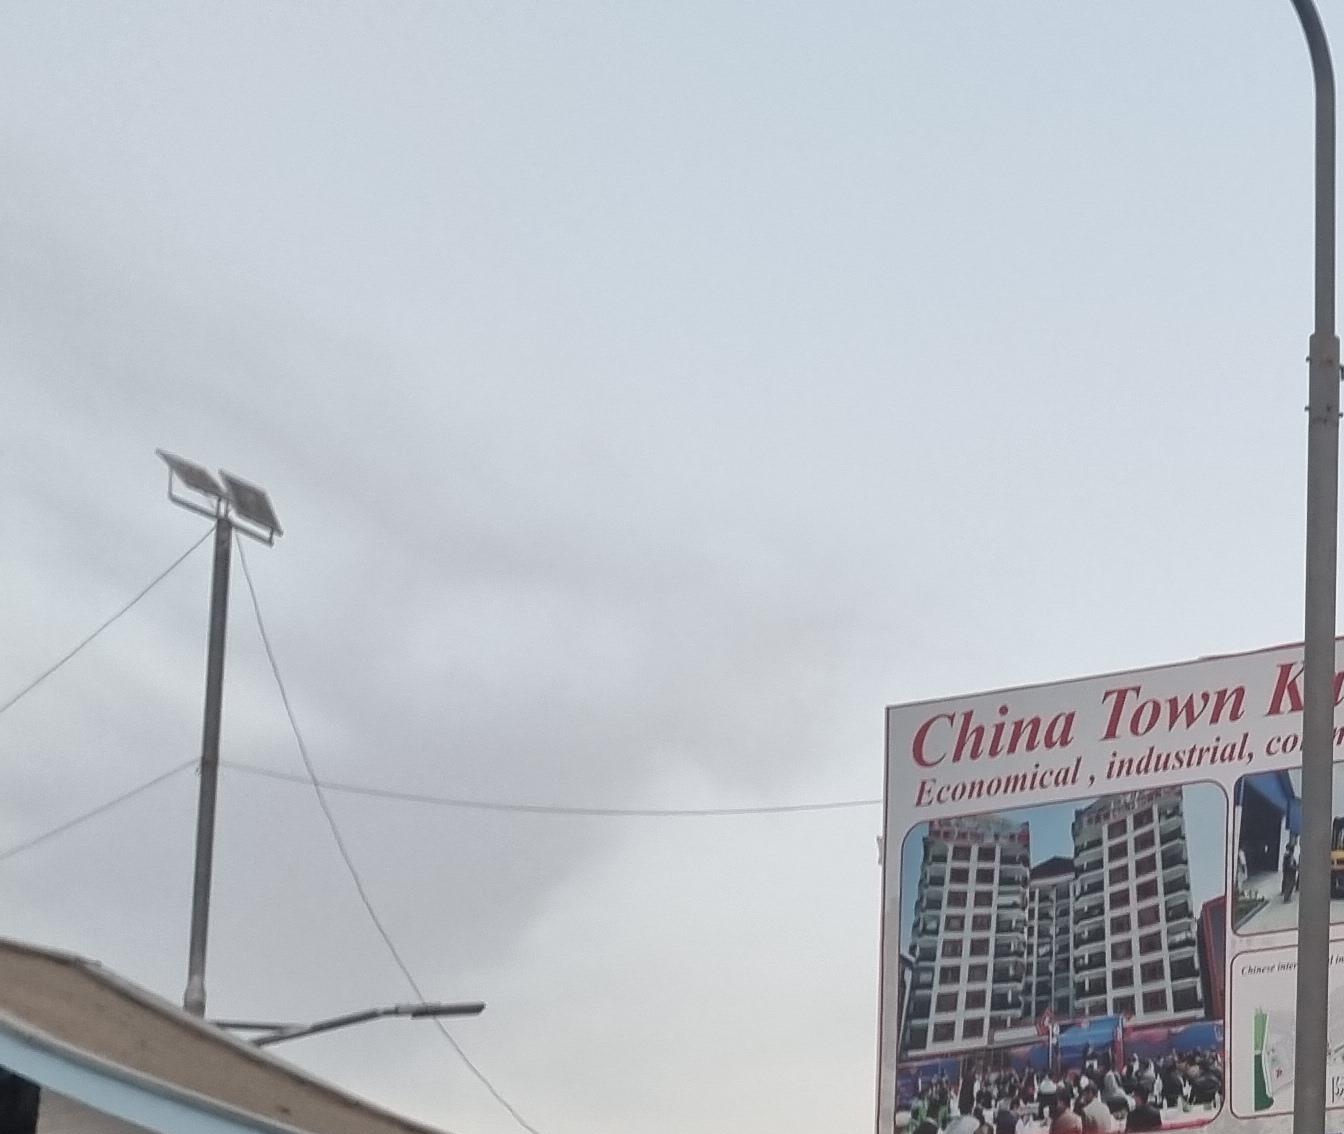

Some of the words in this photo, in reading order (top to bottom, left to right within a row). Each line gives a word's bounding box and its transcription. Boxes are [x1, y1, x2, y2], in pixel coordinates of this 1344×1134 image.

[911, 704, 1077, 769] China
[1099, 684, 1246, 742] Town
[914, 756, 1083, 808] Economical
[1105, 732, 1254, 781] industrial,
[1241, 963, 1276, 977] Chinese
